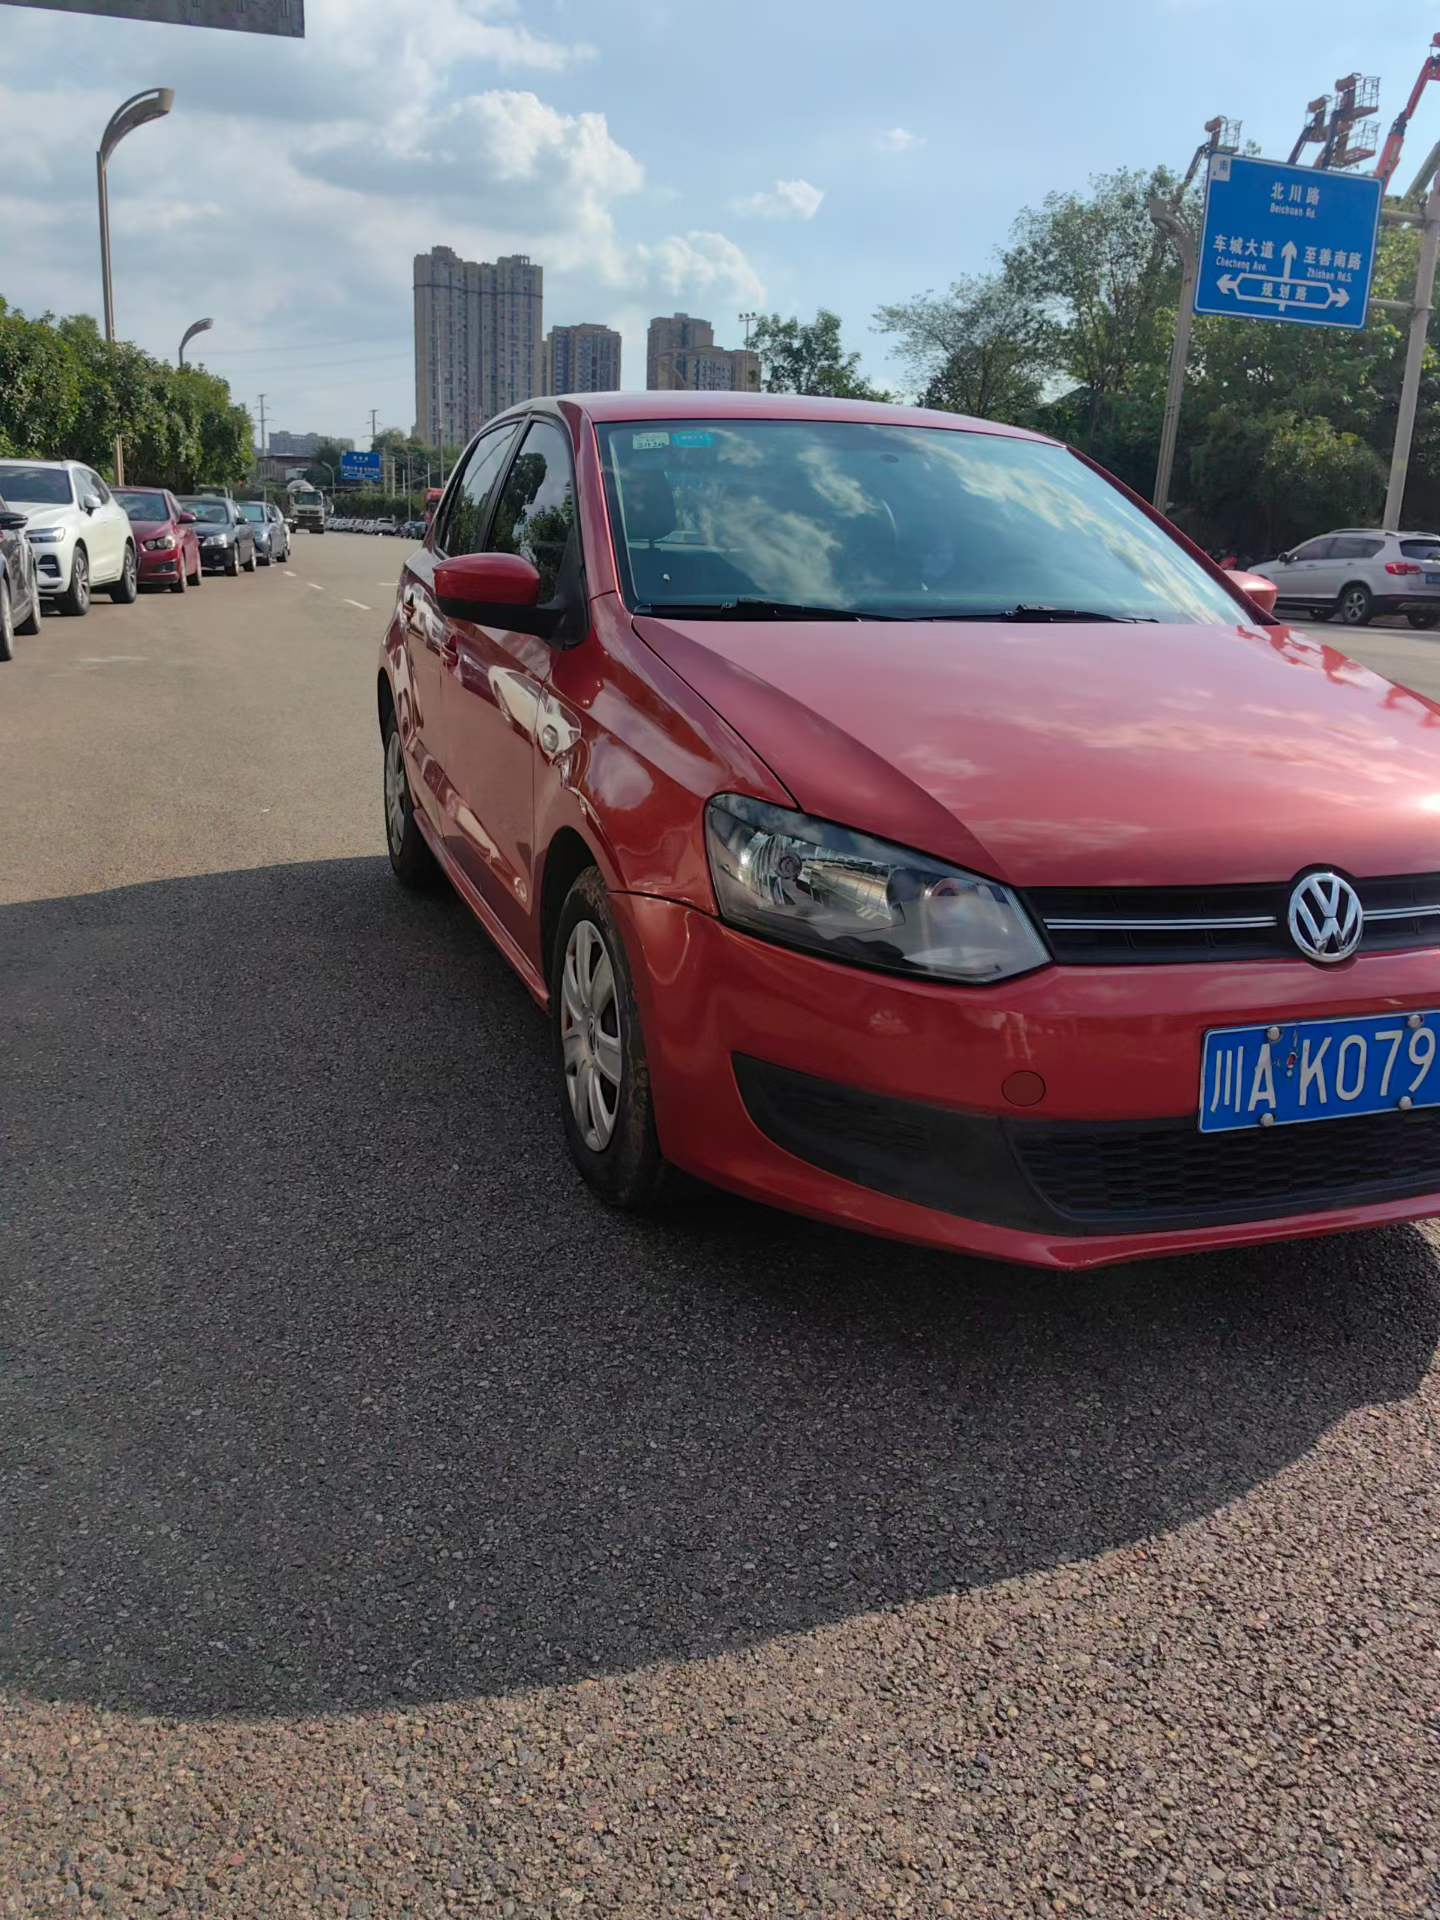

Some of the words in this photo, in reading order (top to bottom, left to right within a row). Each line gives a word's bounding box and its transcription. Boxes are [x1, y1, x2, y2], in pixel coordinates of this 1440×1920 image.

[1271, 182, 1320, 206] 北川路
[1213, 234, 1274, 259] 车城大道
[1304, 246, 1361, 270] 至善南路
